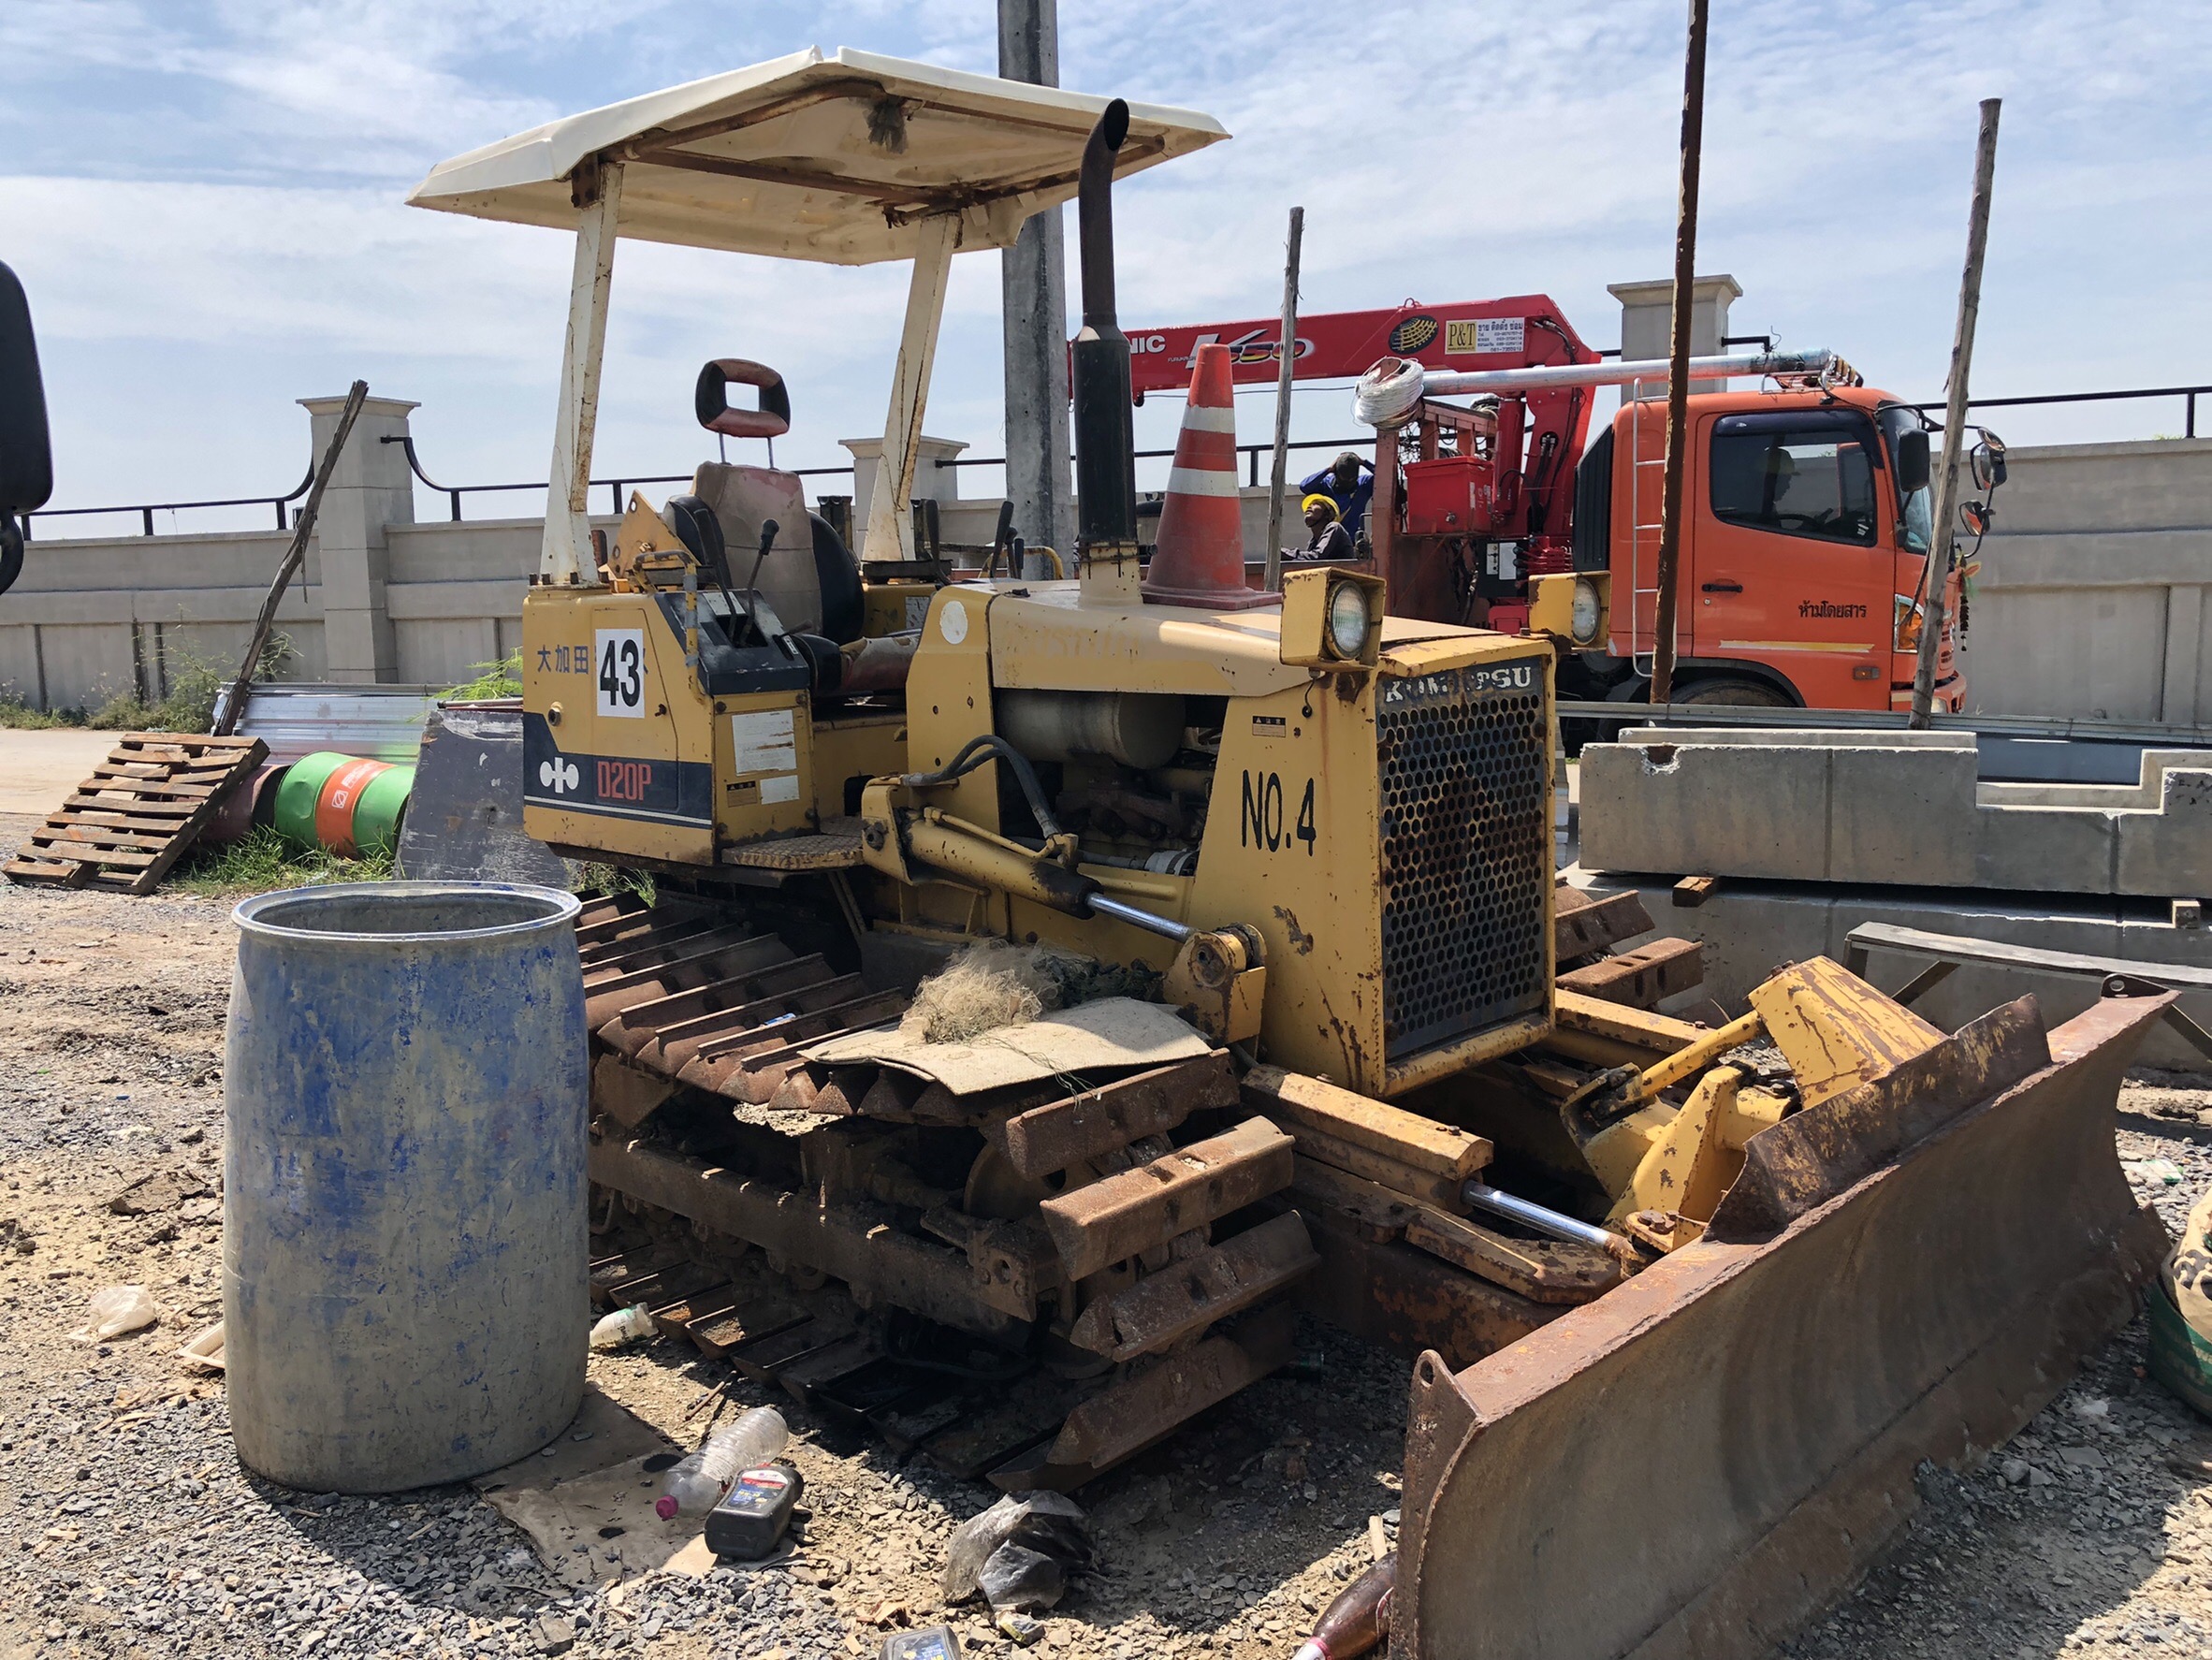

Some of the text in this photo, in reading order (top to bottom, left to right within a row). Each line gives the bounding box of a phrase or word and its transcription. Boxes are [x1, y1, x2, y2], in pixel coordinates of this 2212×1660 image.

[1129, 335, 1167, 355] NIC
[1448, 323, 1476, 346] P&T
[1797, 600, 1868, 619] ห้ามโดยสาร
[599, 639, 641, 707] 43
[597, 761, 652, 801] D20P
[1241, 769, 1317, 857] NO.4
